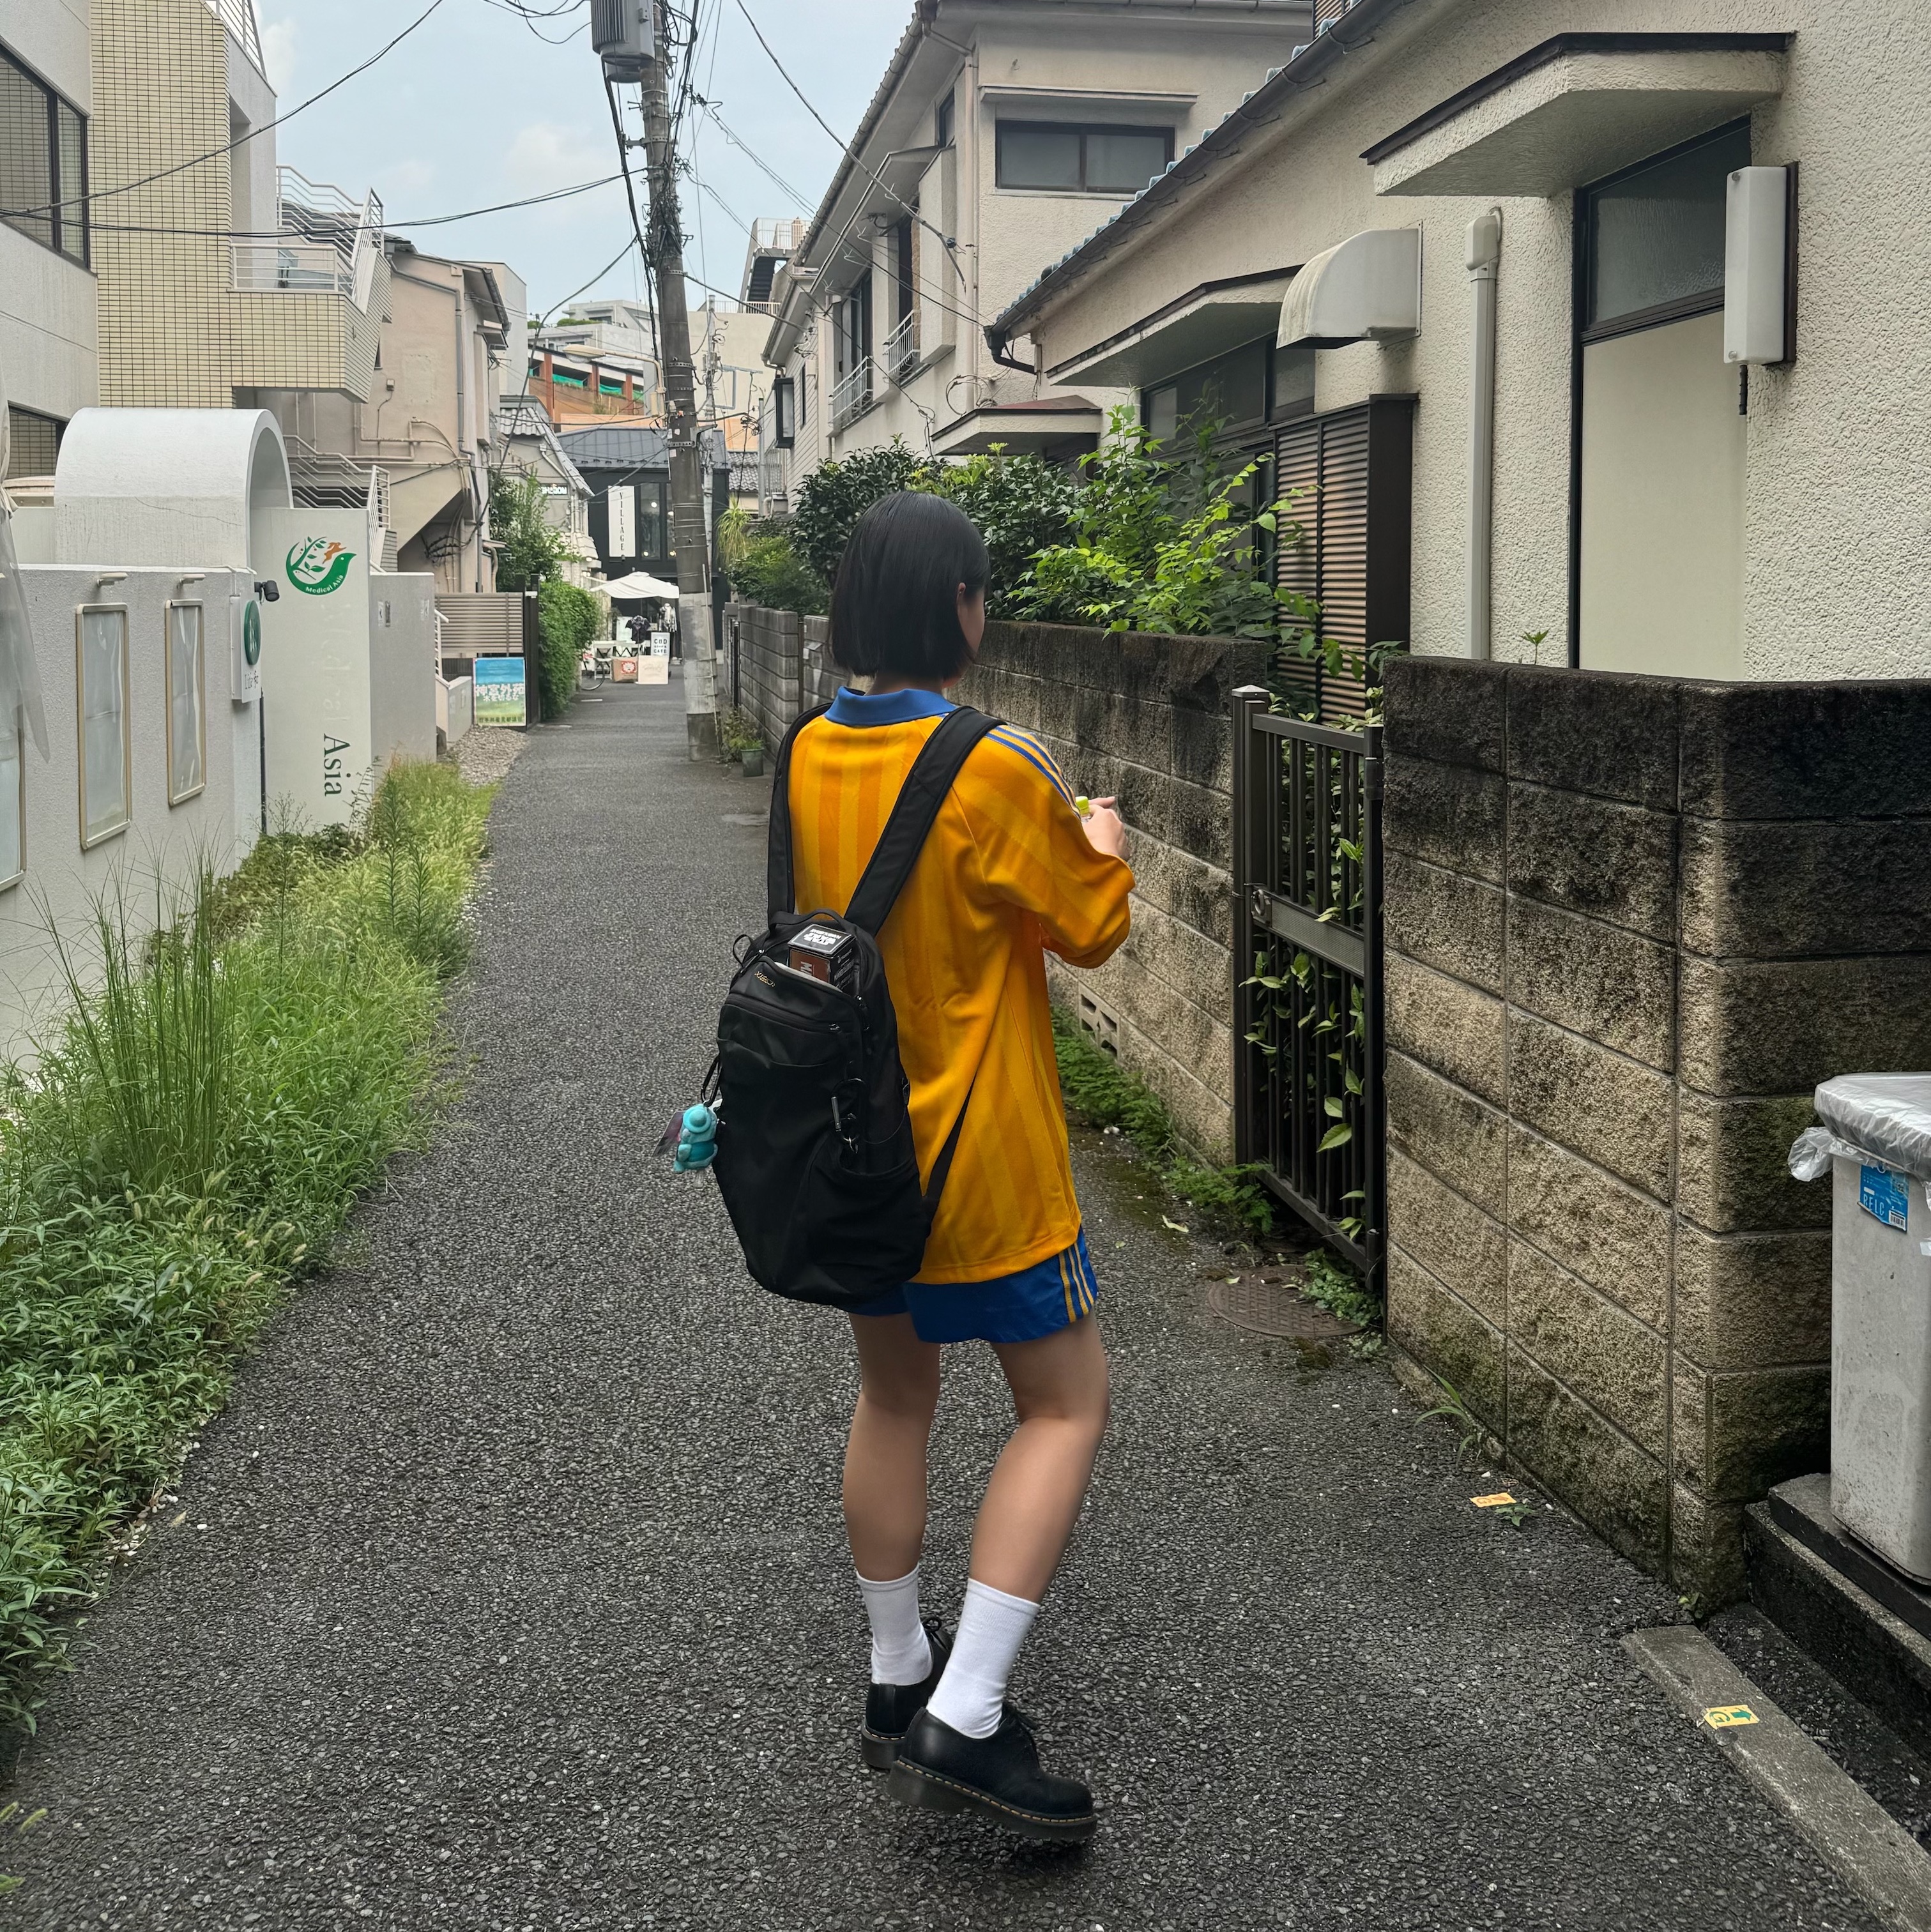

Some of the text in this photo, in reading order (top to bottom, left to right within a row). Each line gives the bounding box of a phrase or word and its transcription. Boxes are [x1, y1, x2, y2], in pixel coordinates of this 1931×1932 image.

[305, 575, 344, 594] Medical Asia
[323, 733, 351, 796] Asia
[1709, 1711, 1730, 1723] G
